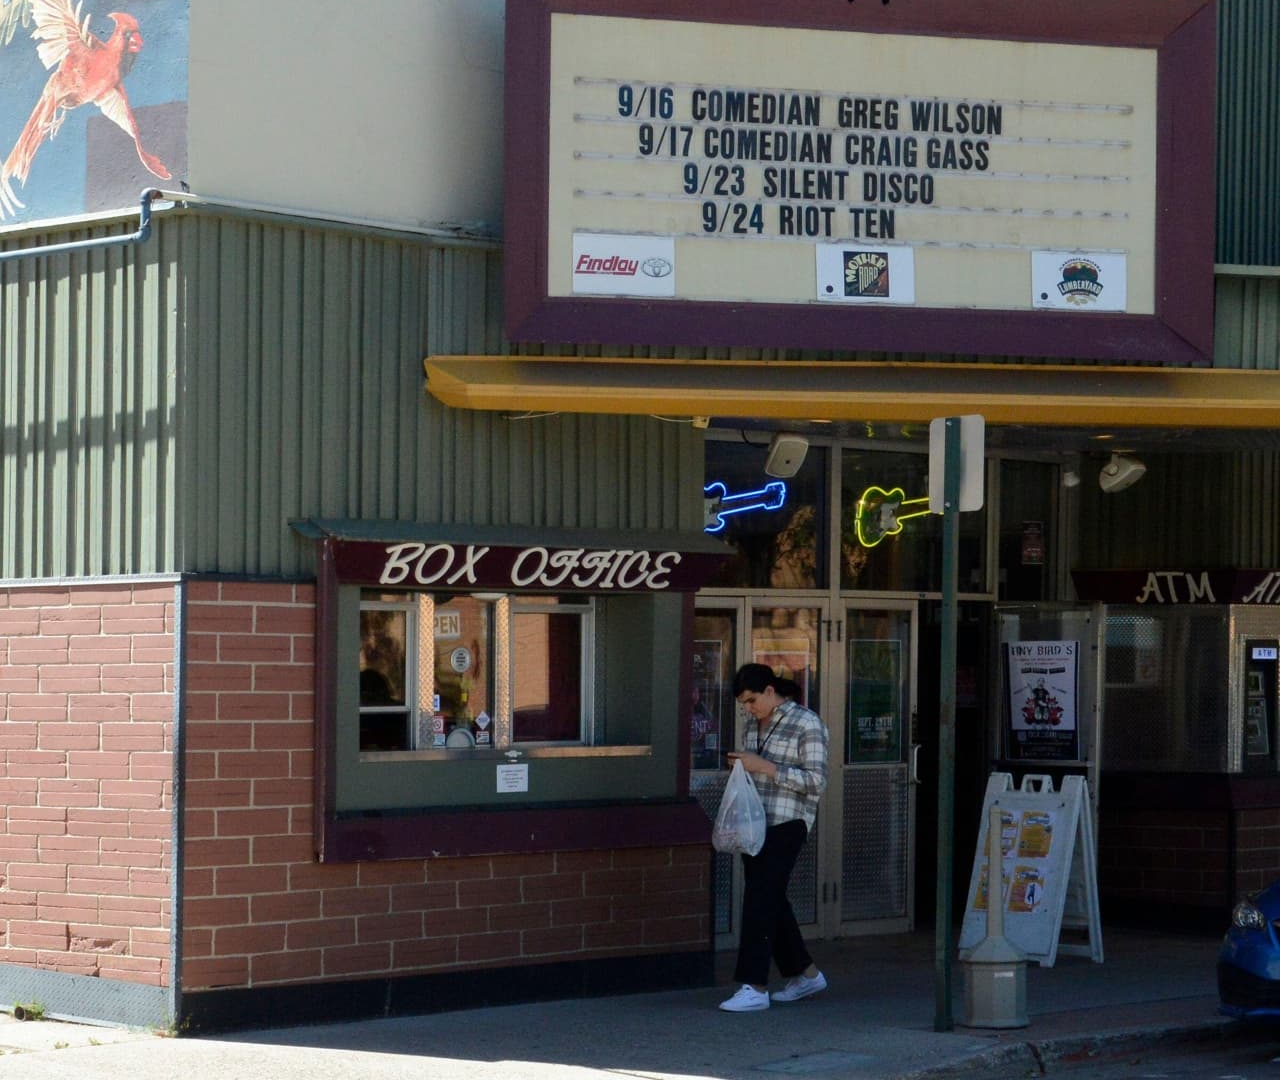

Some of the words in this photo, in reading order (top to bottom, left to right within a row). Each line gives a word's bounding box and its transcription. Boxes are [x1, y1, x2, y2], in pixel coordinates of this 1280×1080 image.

[618, 84, 674, 118] 9/16
[691, 89, 821, 126] COMEDIAN
[837, 96, 899, 130] GREG
[910, 100, 1003, 135] WILSON
[638, 122, 694, 157] 9/17
[703, 127, 833, 164] COMEDIAN
[845, 134, 918, 169] CRAIG
[926, 137, 990, 171] GASS
[683, 161, 745, 196] 9/23
[763, 167, 849, 202] SILENT
[863, 171, 935, 205] DISCO
[702, 201, 764, 235] 9/24
[779, 205, 836, 238] RIOT
[849, 209, 896, 239] TEN
[575, 254, 640, 275] Findlay
[845, 253, 887, 283] MOTHER
[379, 542, 490, 585] BOX
[510, 545, 682, 589] OFFICE
[1135, 571, 1217, 604] ATM
